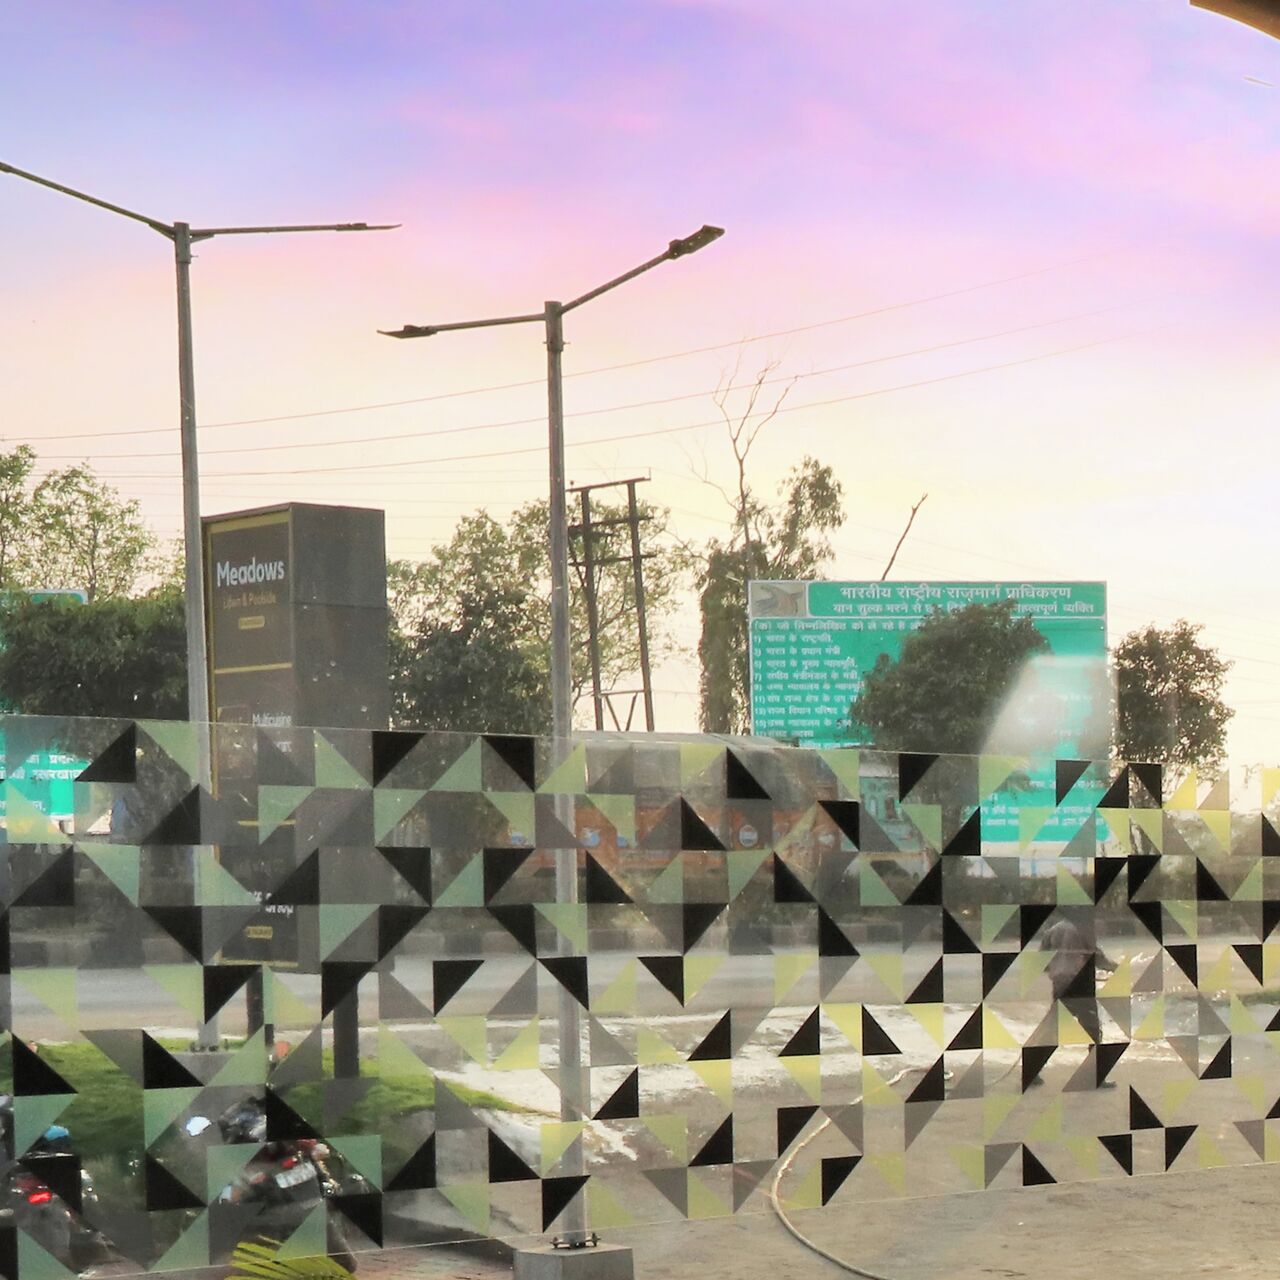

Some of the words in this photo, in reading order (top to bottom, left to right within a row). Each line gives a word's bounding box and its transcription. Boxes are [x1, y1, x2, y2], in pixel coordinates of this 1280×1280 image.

[217, 556, 285, 588] Meadows
[841, 583, 891, 599] भारतीय
[946, 584, 1000, 600] राजमार्ग
[1006, 584, 1072, 599] प्राधिकरण
